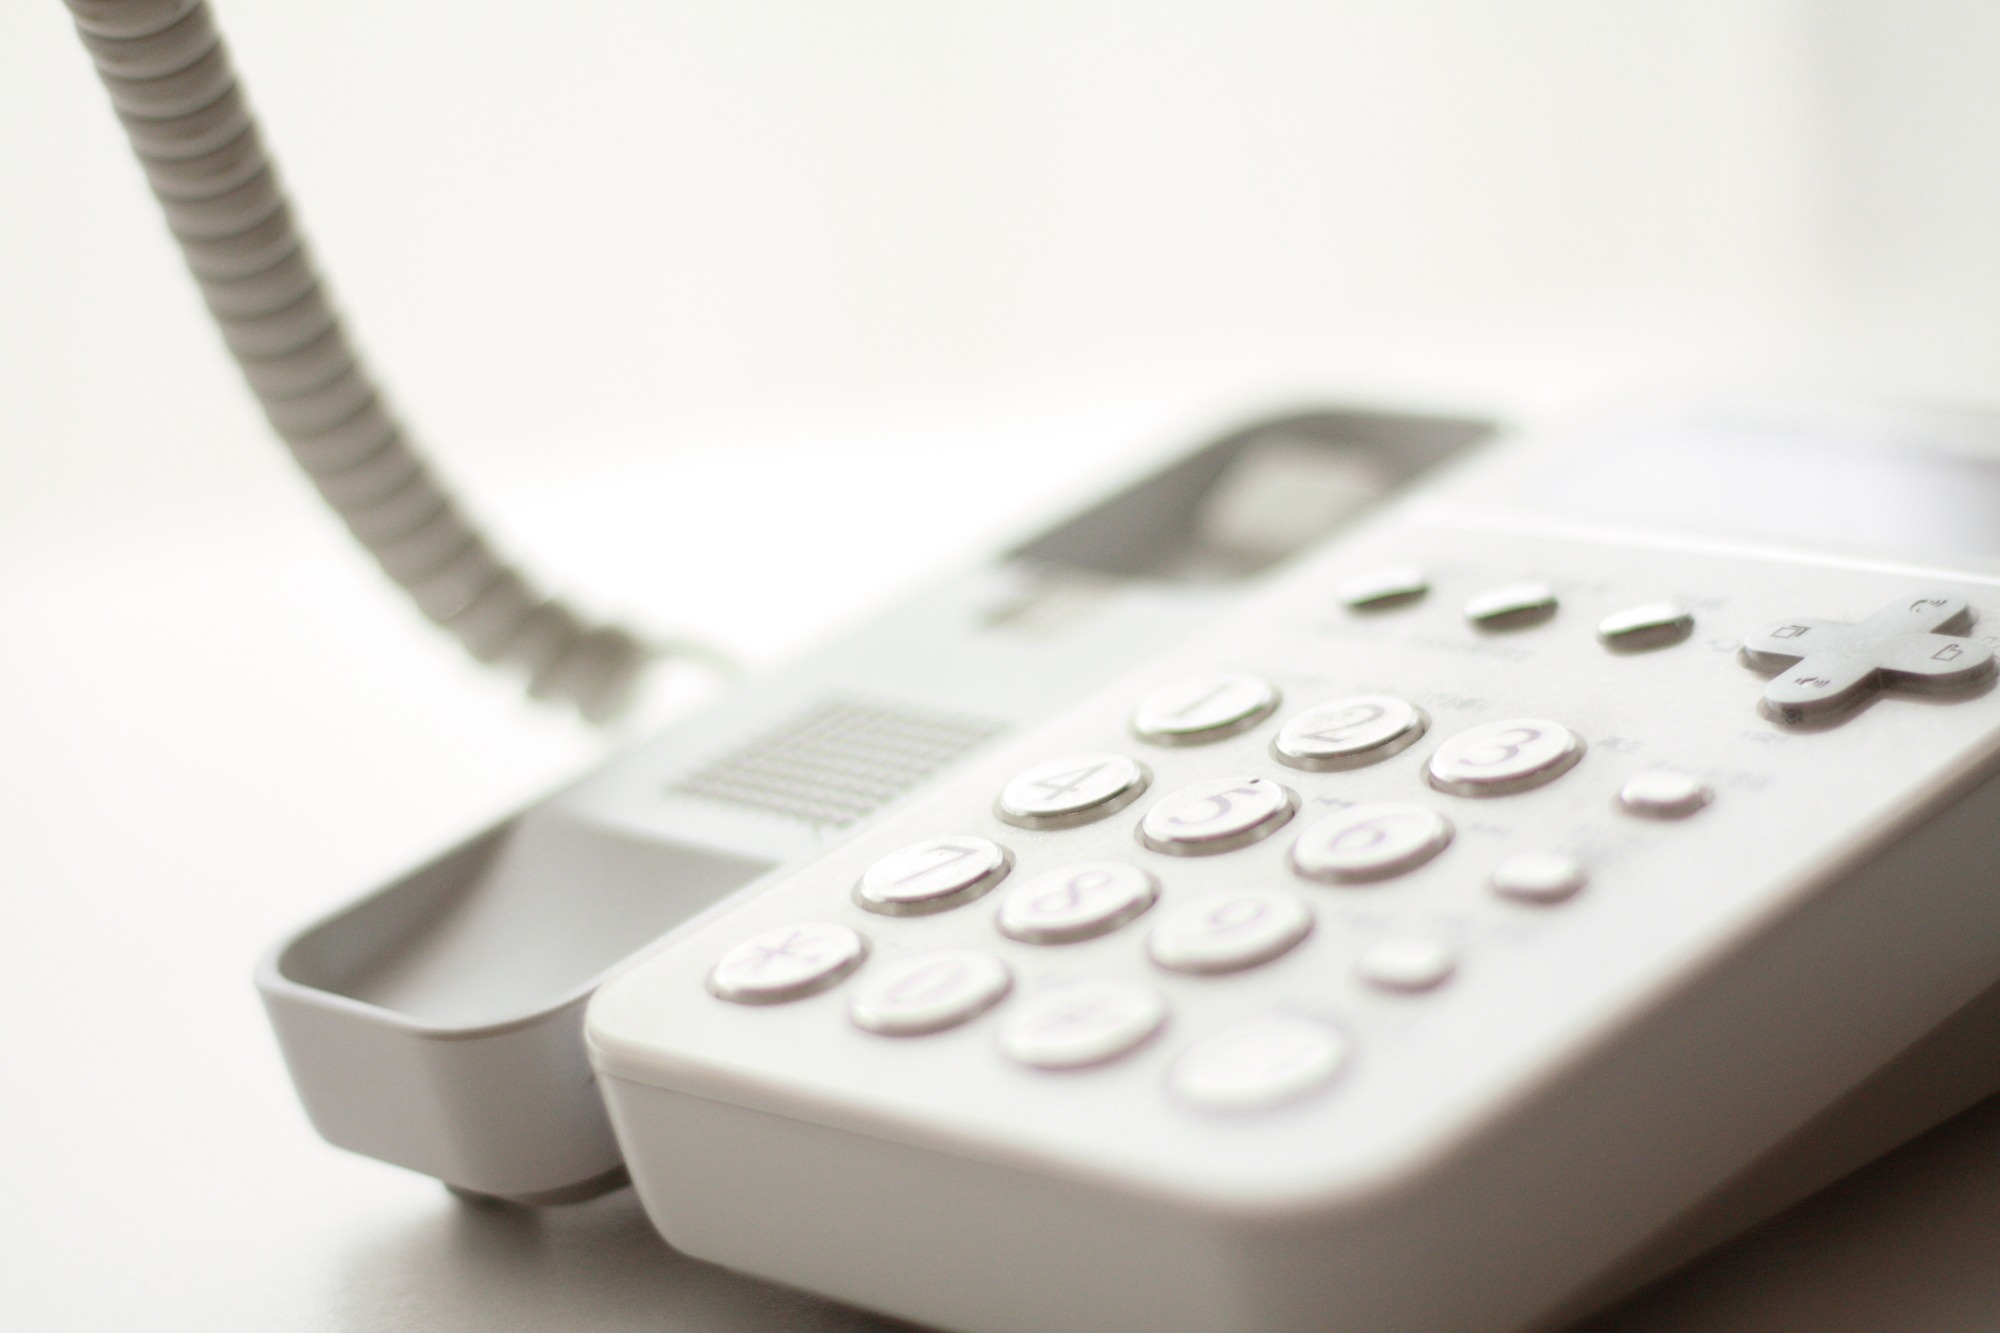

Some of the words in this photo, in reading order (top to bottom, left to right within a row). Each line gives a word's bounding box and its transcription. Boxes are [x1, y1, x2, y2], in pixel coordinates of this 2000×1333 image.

[1299, 703, 1387, 744] 2
[1458, 727, 1542, 766] 3
[1031, 762, 1110, 800] 4
[1167, 785, 1262, 825] 5
[1325, 811, 1413, 852] 6
[893, 844, 981, 886] 7
[1030, 871, 1113, 912] 8
